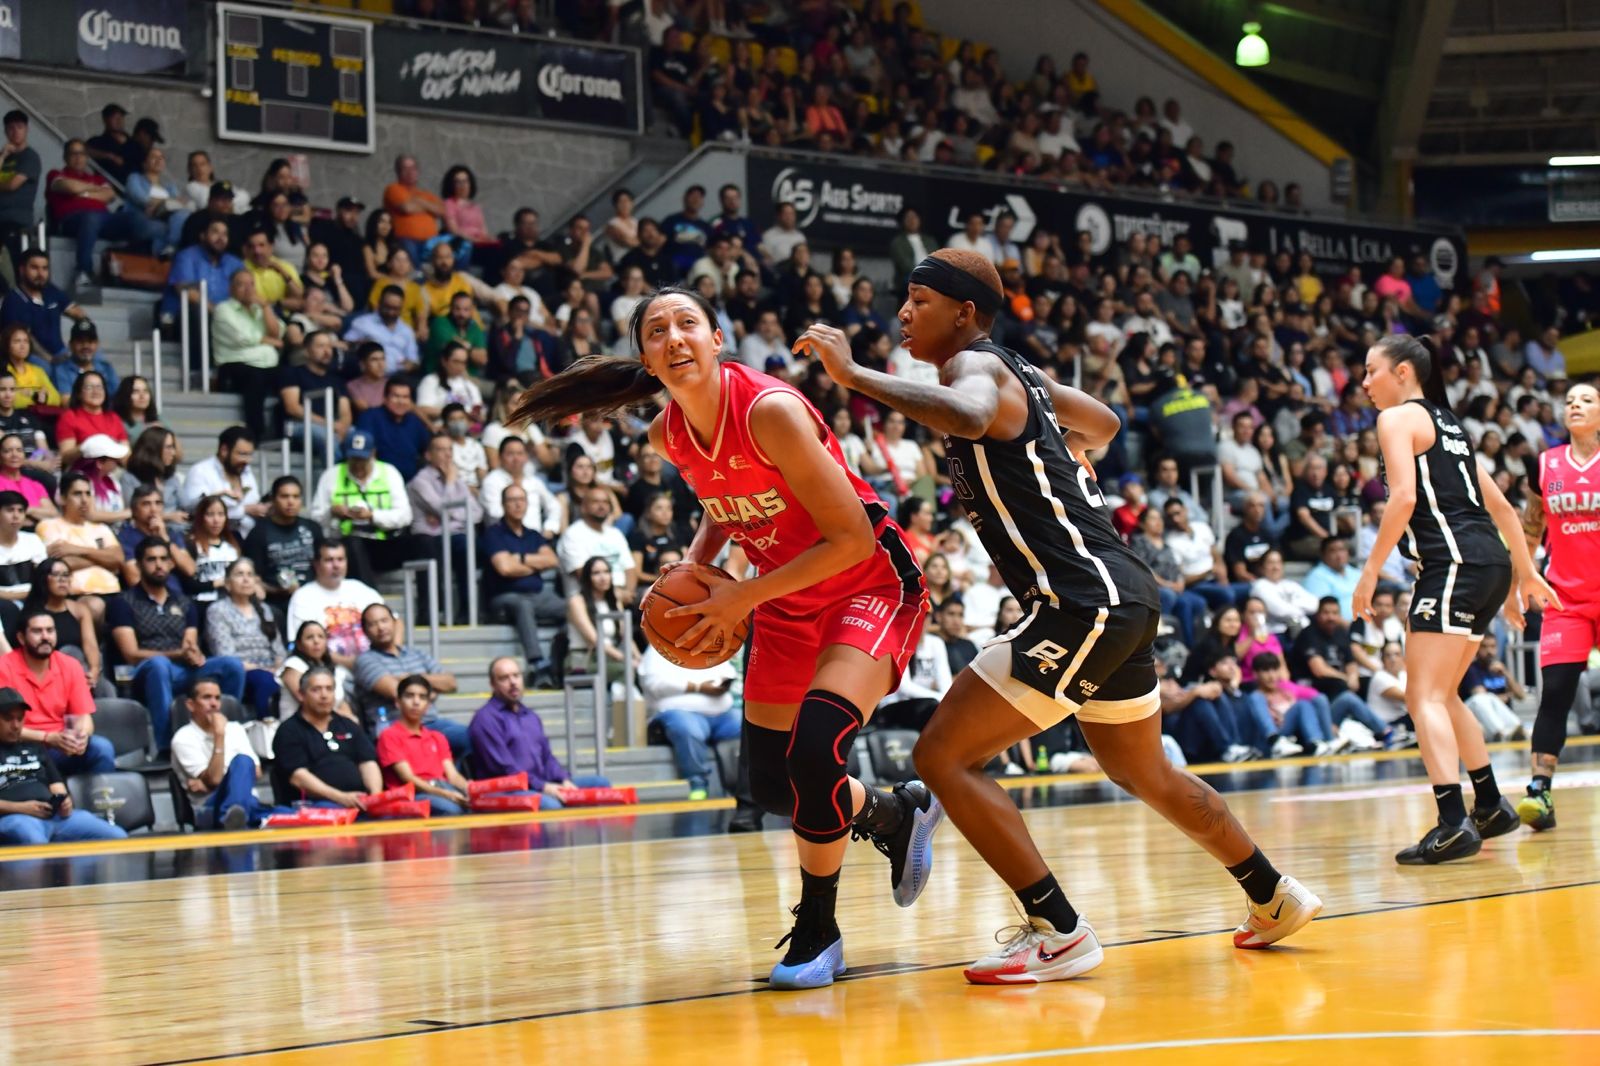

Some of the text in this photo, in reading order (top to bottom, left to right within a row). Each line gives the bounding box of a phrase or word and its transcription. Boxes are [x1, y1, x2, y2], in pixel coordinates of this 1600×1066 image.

[78, 9, 187, 52] Corona
[421, 76, 457, 100] QUE
[537, 64, 624, 102] Corona
[1458, 460, 1480, 507] 1
[699, 487, 788, 524] OJAS
[1547, 490, 1600, 515] ROJA
[1561, 519, 1600, 535] Come
[841, 615, 876, 633] TECATE
